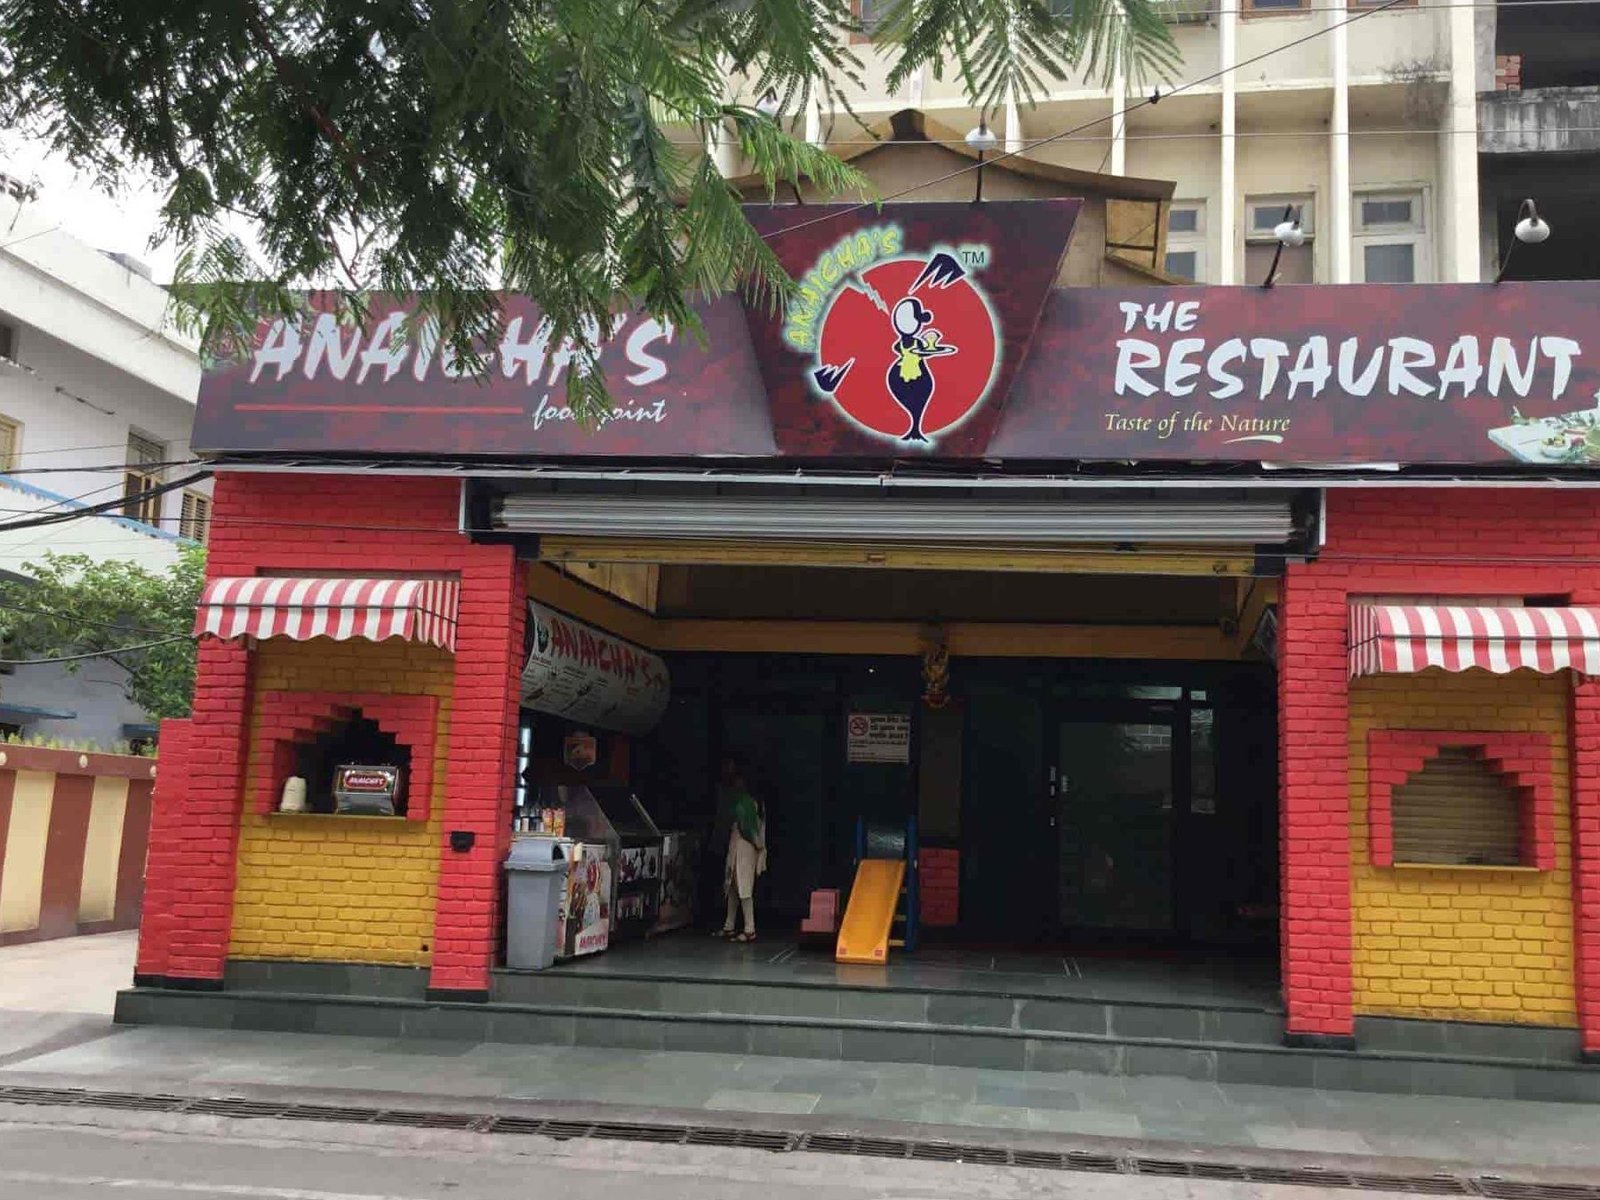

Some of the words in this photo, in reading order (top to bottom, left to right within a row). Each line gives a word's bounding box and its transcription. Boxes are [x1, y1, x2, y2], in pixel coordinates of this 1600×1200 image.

[962, 250, 985, 265] TM
[1120, 300, 1200, 333] THE
[1114, 334, 1582, 401] RESTAURANT
[1104, 412, 1151, 433] Taste
[1157, 412, 1180, 439] of
[1183, 412, 1212, 433] the
[1219, 413, 1291, 433] Nature
